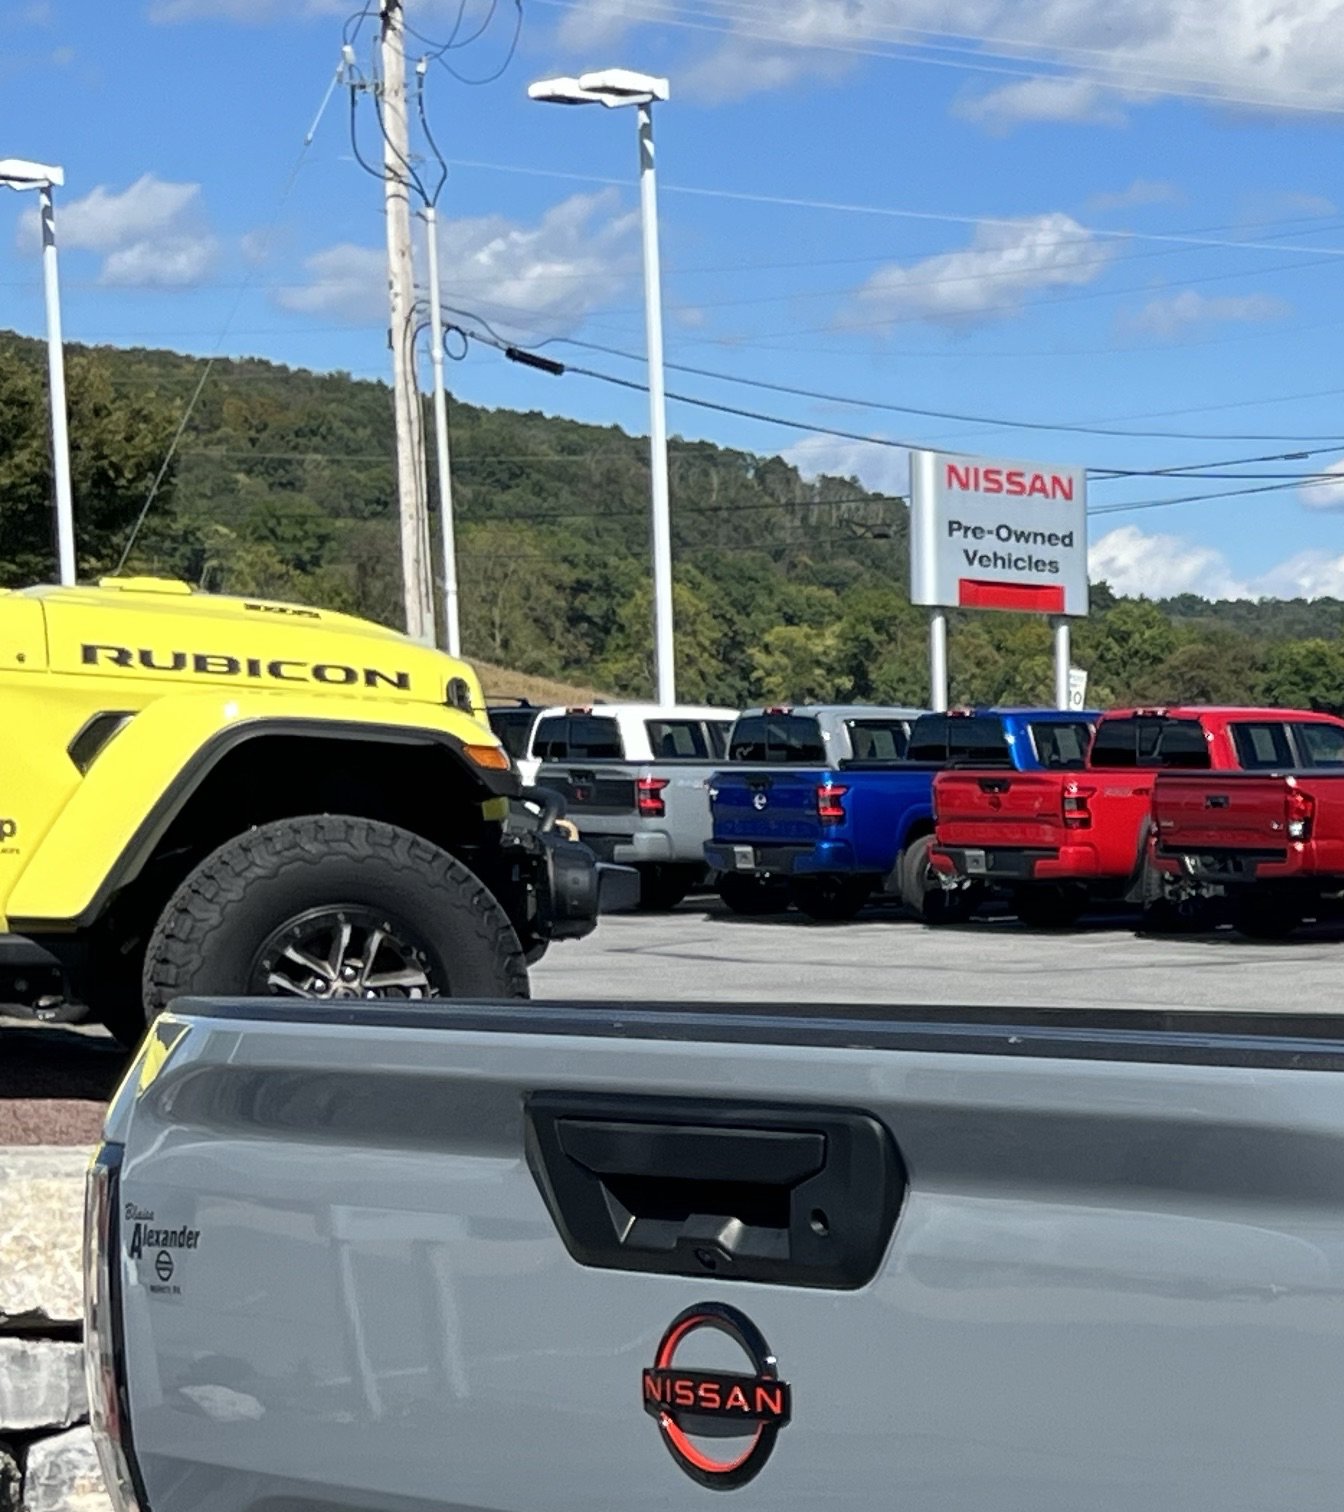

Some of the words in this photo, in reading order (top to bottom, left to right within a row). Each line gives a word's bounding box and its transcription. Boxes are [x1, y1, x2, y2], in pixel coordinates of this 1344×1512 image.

[946, 464, 1073, 501] NISSAN
[948, 520, 1074, 548] Pre-Owned
[962, 549, 1060, 574] Vehicles
[81, 643, 411, 691] RUBICON
[129, 1222, 200, 1260] Alexander
[644, 1374, 783, 1415] NISSAN
